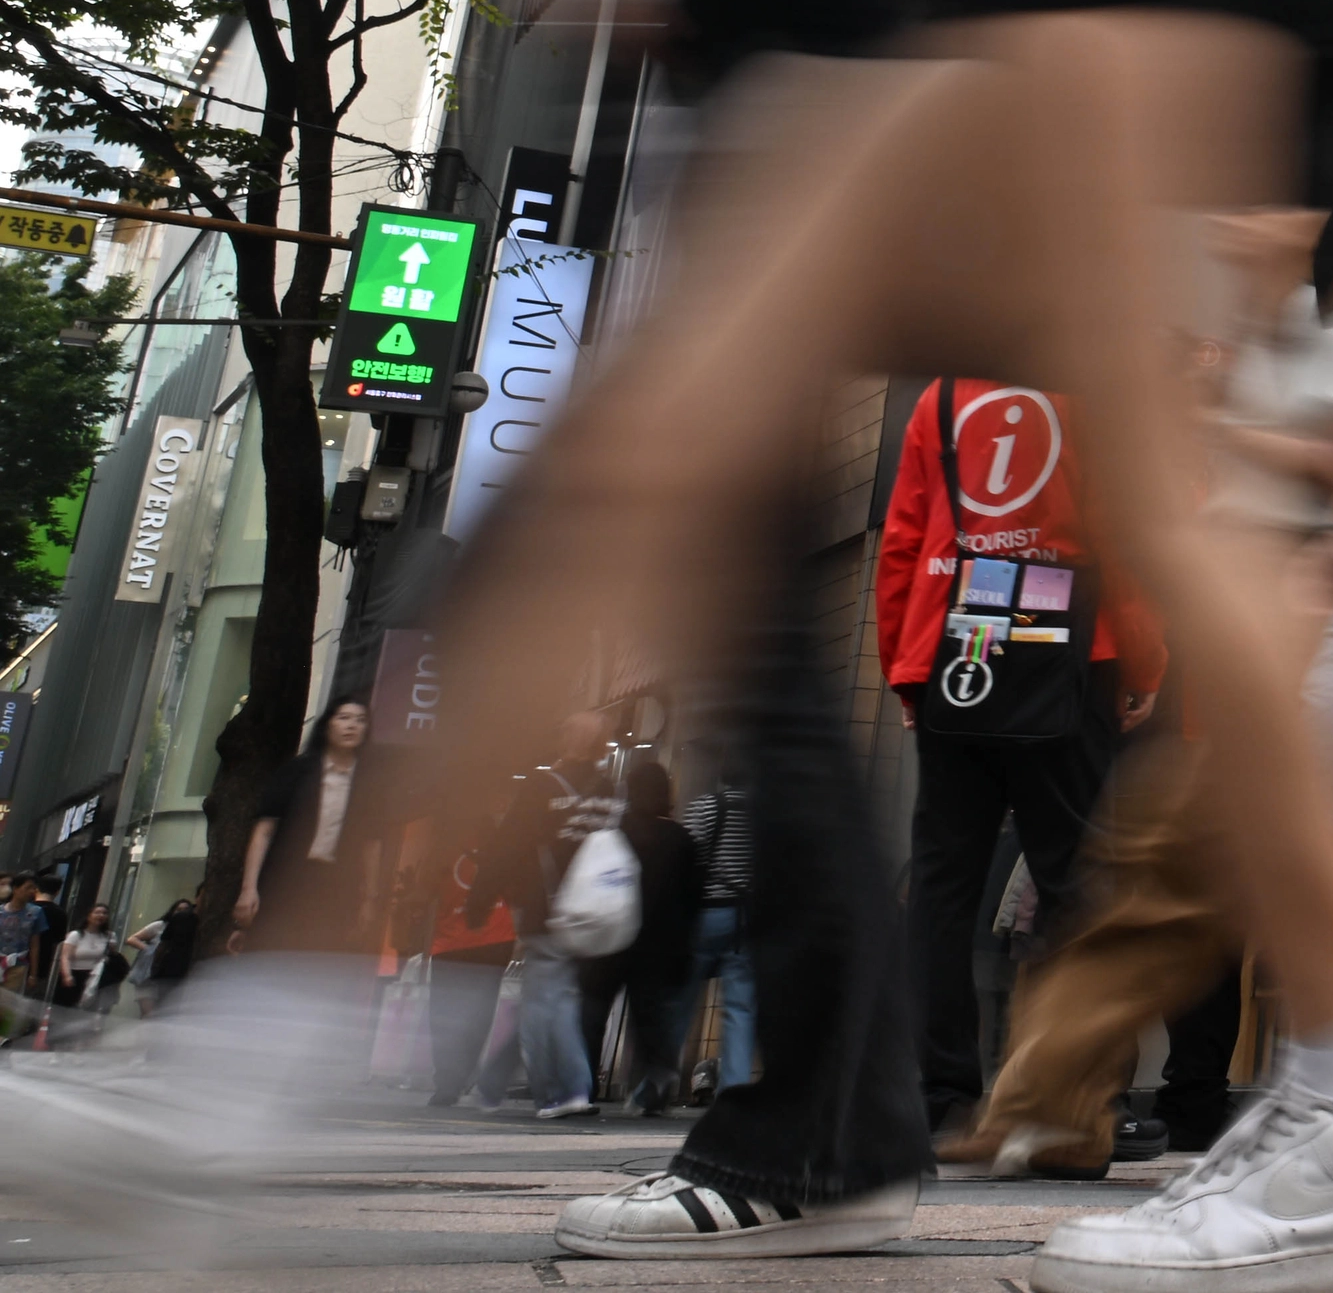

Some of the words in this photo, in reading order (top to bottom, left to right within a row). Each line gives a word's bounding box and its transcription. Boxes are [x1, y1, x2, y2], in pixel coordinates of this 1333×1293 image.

[8, 216, 66, 244] 작동중
[351, 358, 434, 384] 안전보행!
[126, 428, 195, 590] COVERNAT
